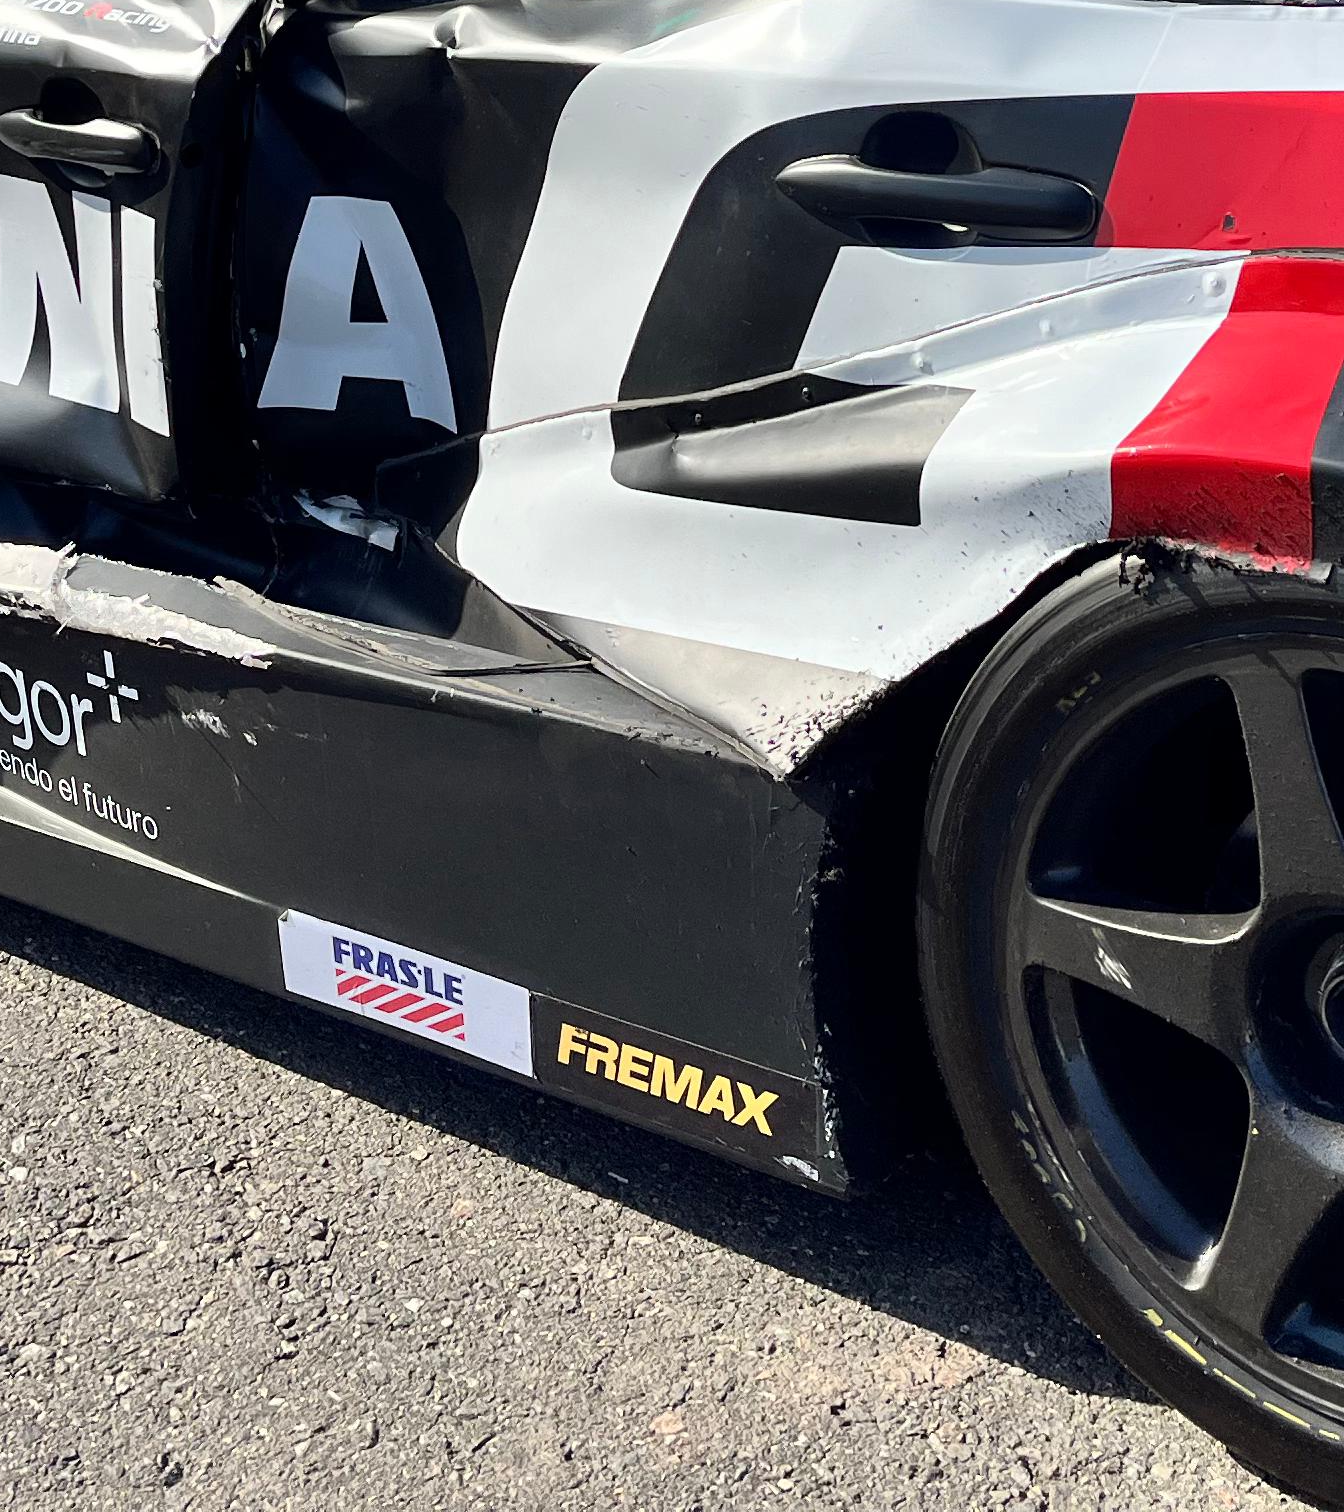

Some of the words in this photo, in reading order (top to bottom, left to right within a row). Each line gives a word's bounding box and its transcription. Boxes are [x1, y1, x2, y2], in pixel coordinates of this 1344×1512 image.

[83, 1, 172, 33] Racing
[58, 776, 79, 806] el
[82, 782, 161, 840] futuro
[556, 1021, 781, 1137] FREMAX
